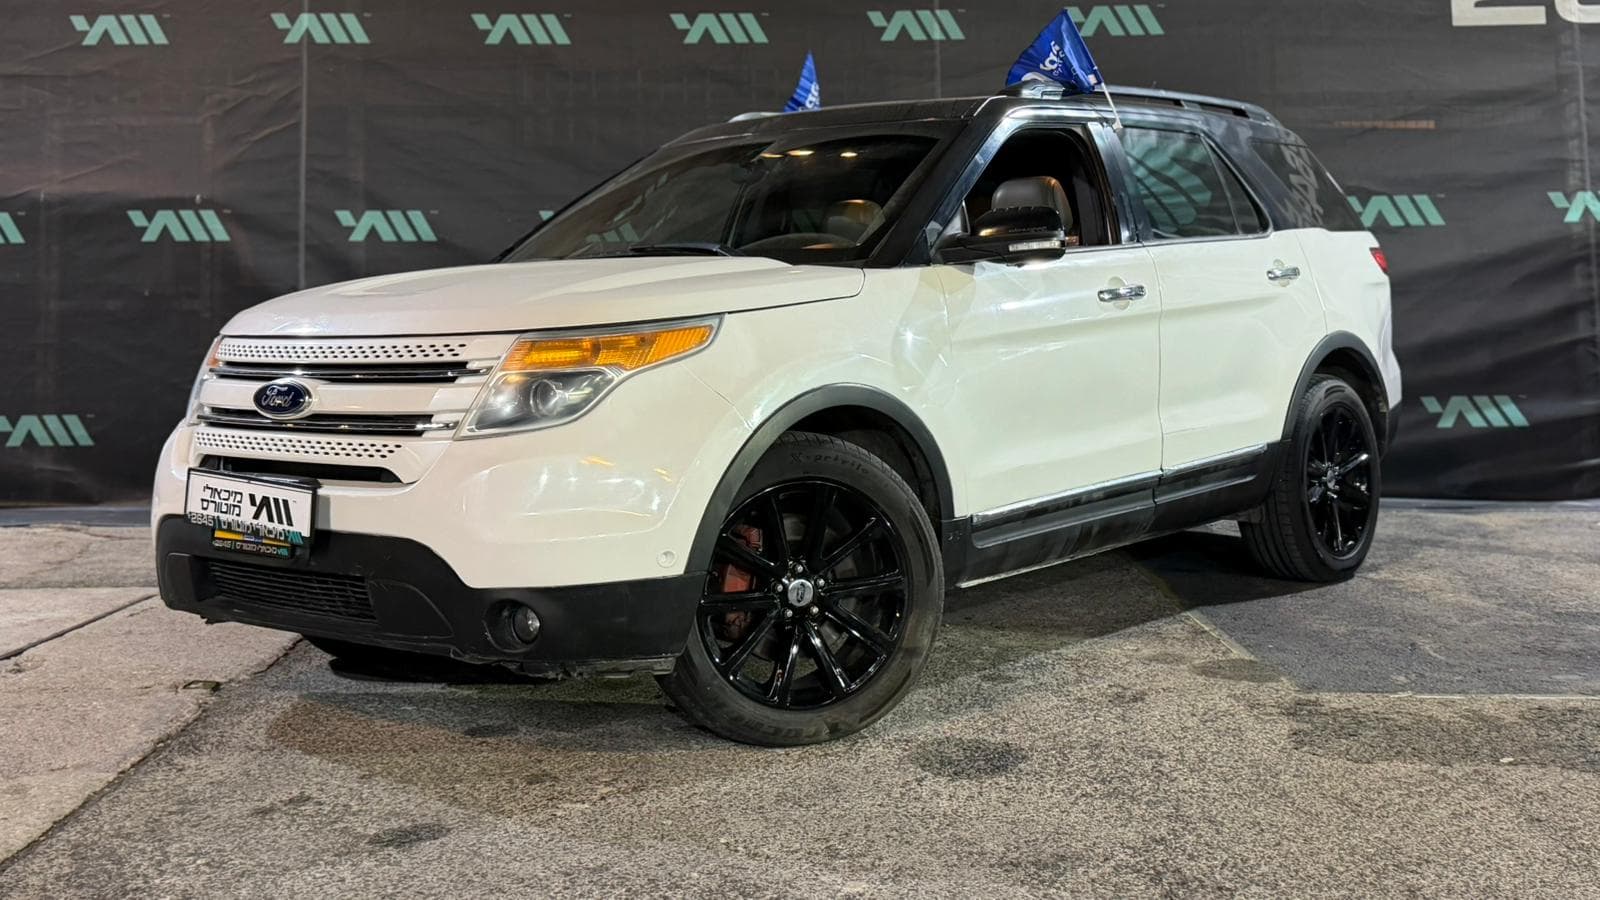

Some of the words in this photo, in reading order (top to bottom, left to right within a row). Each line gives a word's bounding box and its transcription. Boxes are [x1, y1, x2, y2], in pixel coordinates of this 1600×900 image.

[261, 385, 295, 407] Ford
[203, 484, 243, 503] מיכאלי
[201, 498, 241, 516] מוטורס
